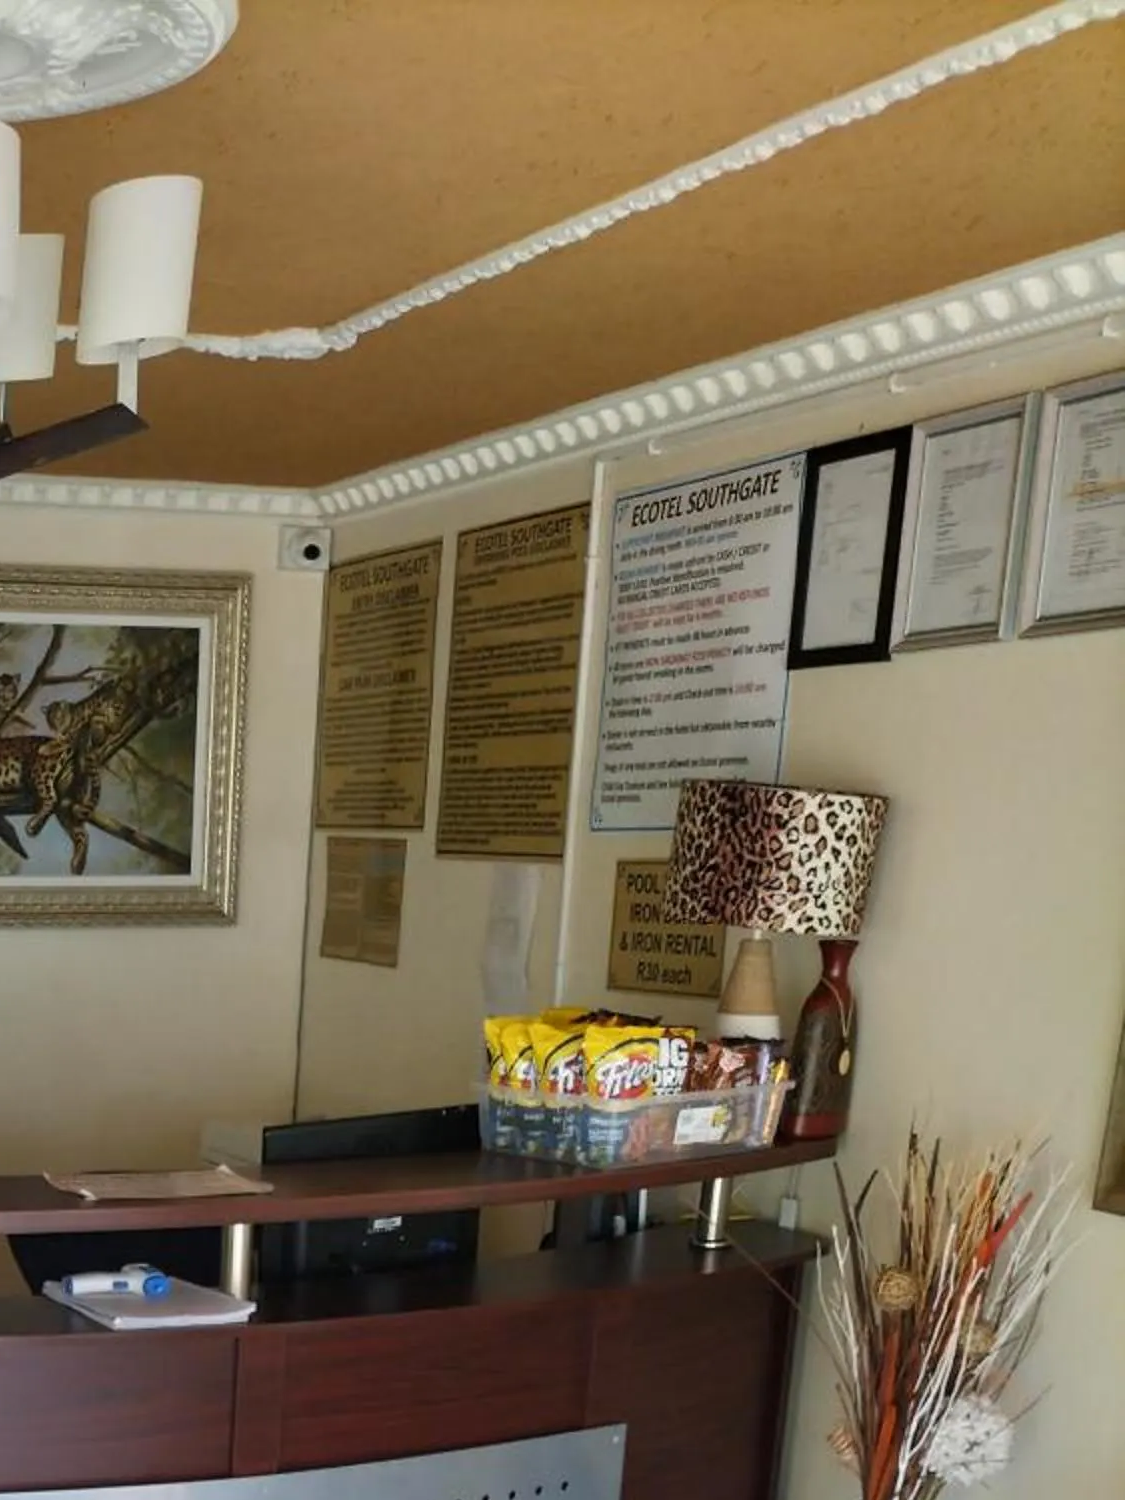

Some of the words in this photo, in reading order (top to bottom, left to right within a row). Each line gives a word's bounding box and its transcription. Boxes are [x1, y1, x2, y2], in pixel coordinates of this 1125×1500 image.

[631, 495, 683, 528] ECOTEL
[686, 469, 782, 514] SOUTHGATE
[626, 872, 661, 895] POOL
[630, 904, 660, 925] IRON
[632, 931, 662, 952] IRON
[664, 933, 717, 957] RENTAL
[661, 963, 692, 985] each
[658, 1037, 688, 1068] IG
